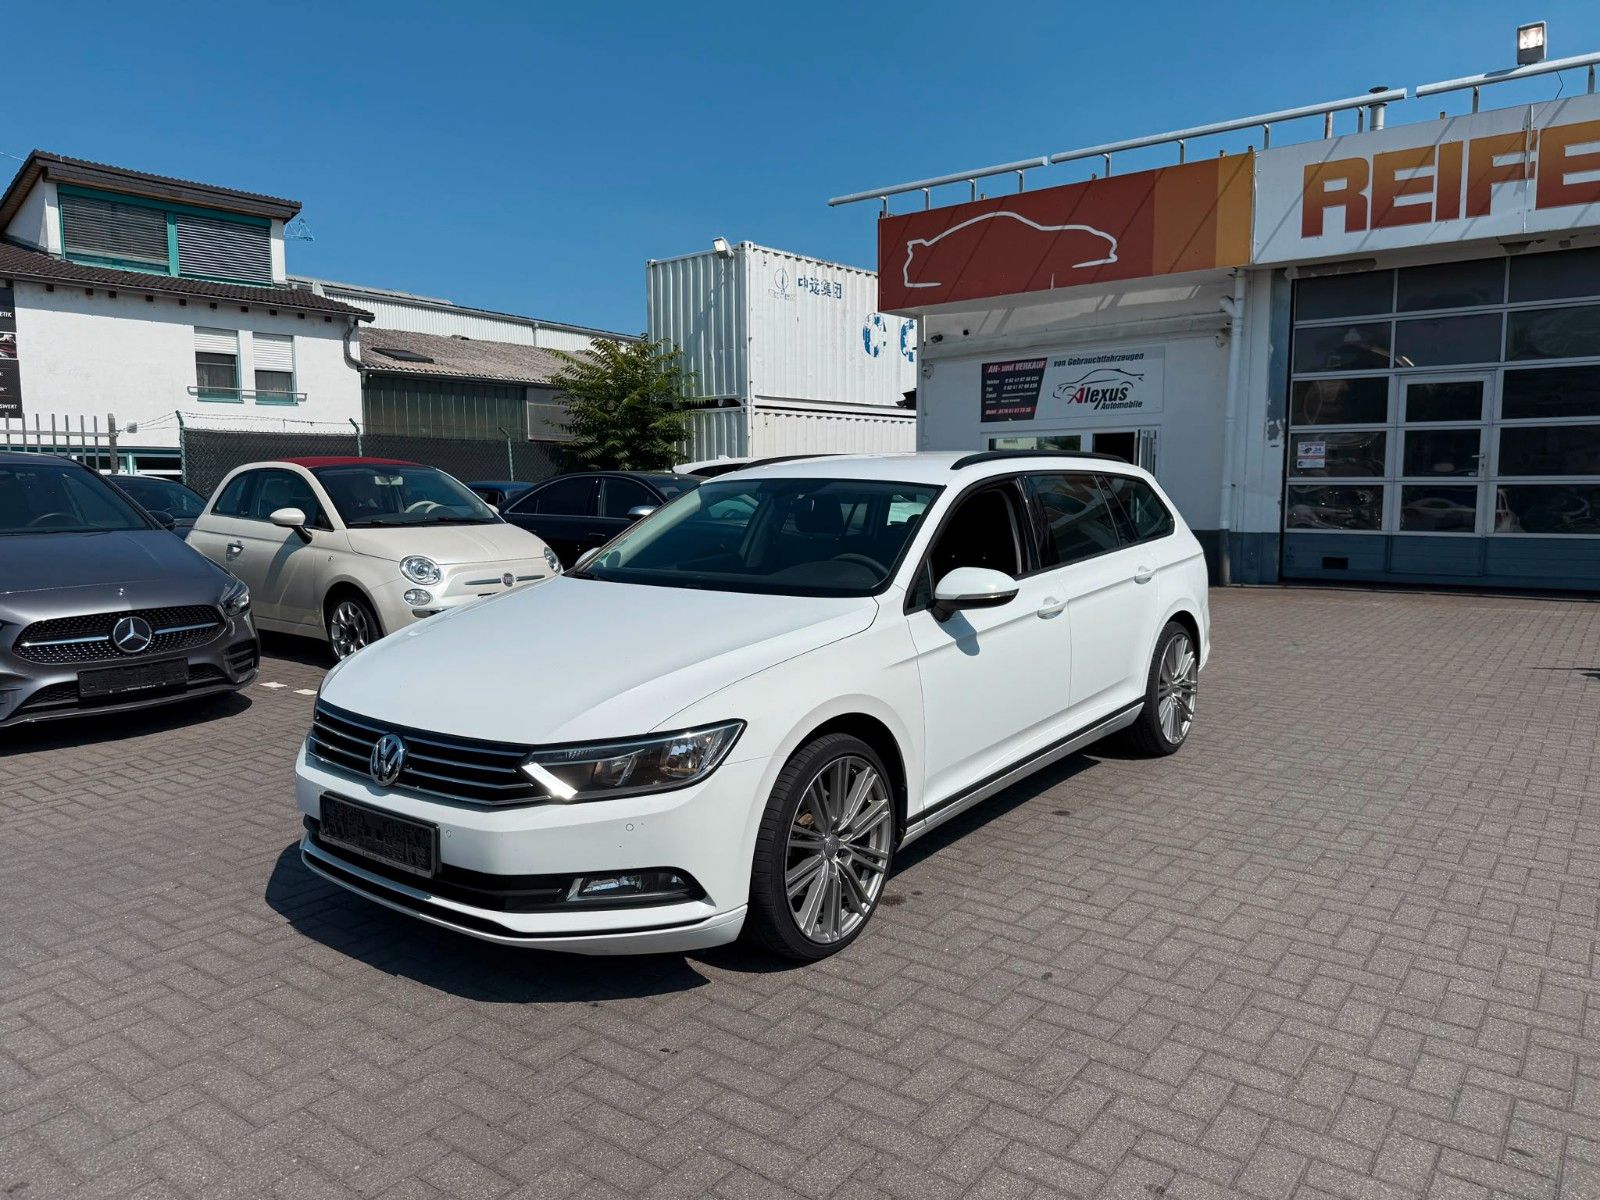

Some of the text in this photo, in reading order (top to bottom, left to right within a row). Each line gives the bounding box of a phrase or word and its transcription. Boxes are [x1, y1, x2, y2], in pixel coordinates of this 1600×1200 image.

[1301, 119, 1600, 239] REIFE
[1015, 361, 1045, 370] VERKAUF
[1053, 352, 1145, 367] von Gebrauchtfahrzeugen
[1067, 384, 1129, 410] Alexus
[1100, 400, 1144, 411] Automobile
